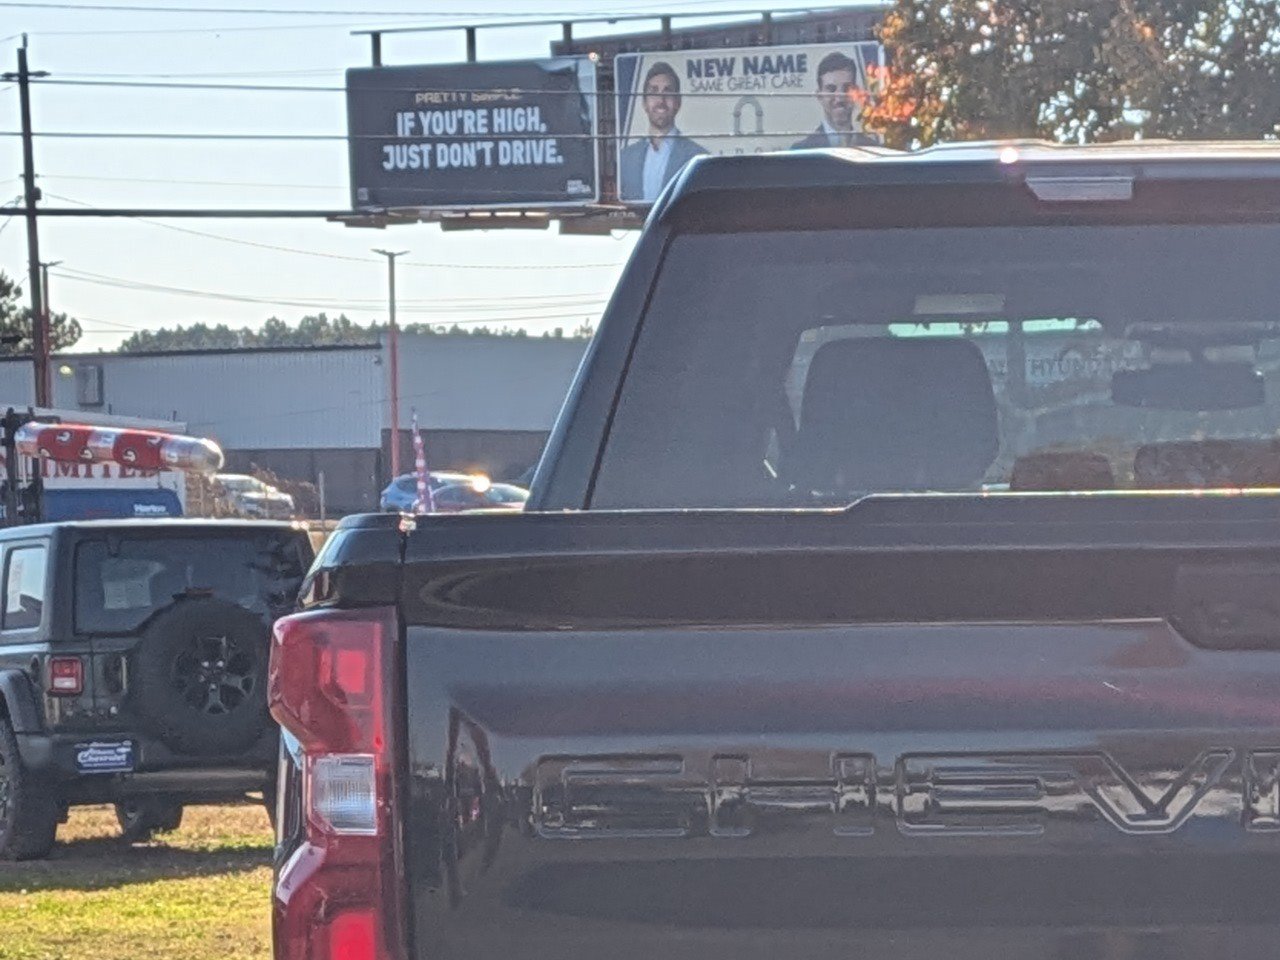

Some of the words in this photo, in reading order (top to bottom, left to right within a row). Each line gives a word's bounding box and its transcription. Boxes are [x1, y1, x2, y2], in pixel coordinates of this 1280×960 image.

[686, 57, 736, 78] NEW
[742, 53, 807, 74] NAME
[690, 77, 724, 92] SAME
[727, 75, 767, 90] GREAT
[771, 73, 804, 89] CARE
[415, 92, 467, 104] PRETTY
[396, 111, 415, 137] IF
[418, 108, 489, 136] YOU'RE
[492, 106, 548, 133] HIGH.
[382, 143, 432, 170] JUST
[436, 140, 494, 168] DON'T
[498, 139, 564, 166] DRIVE.
